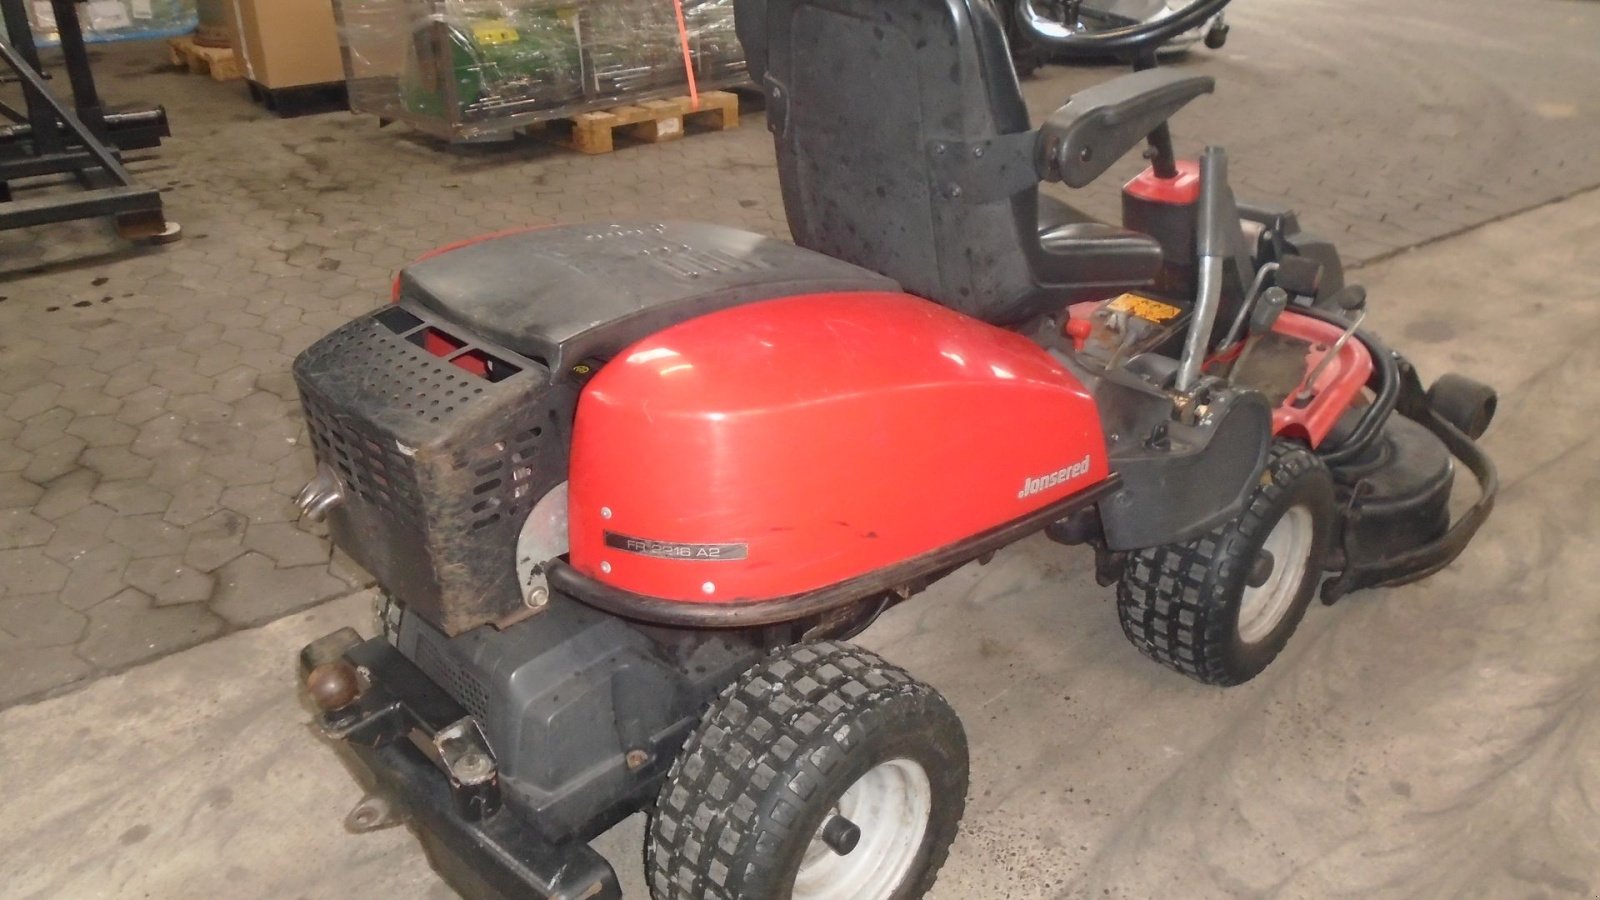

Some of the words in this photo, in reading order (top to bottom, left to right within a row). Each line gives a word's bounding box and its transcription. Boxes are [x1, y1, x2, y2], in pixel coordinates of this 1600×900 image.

[1018, 454, 1090, 498] Jonsered
[627, 540, 646, 552] FR
[652, 544, 690, 556] 2216
[697, 548, 720, 557] A2
